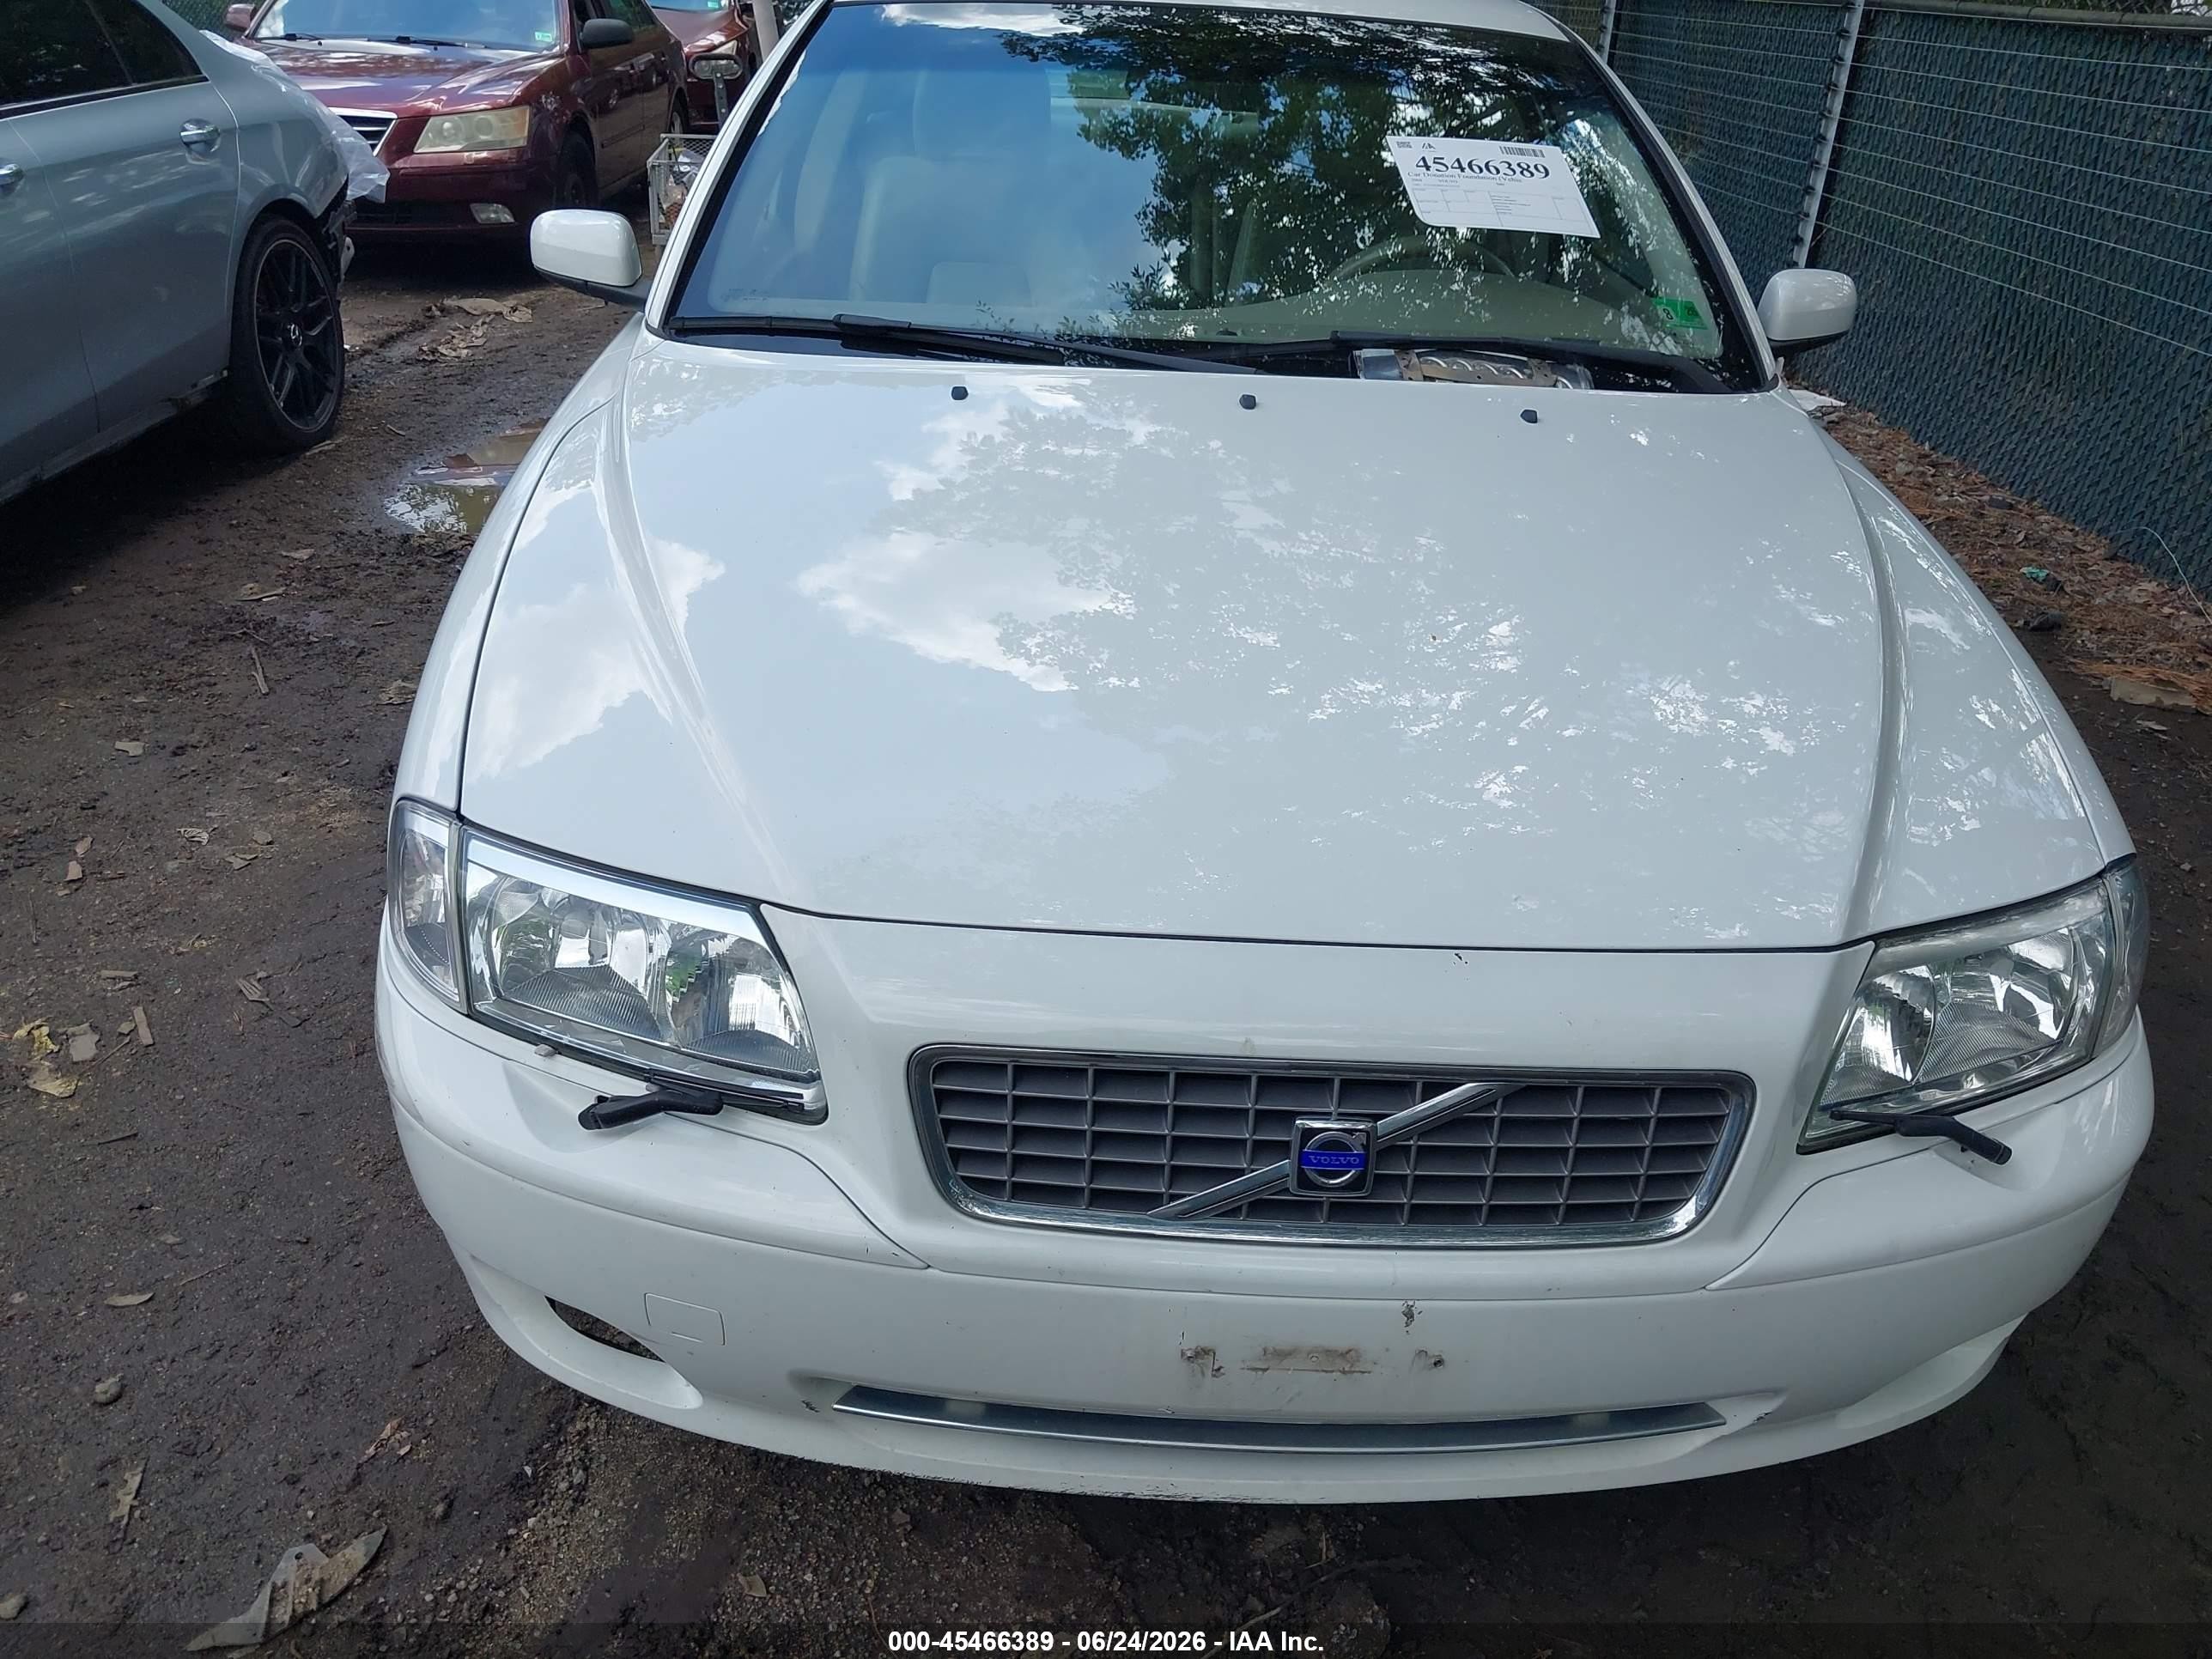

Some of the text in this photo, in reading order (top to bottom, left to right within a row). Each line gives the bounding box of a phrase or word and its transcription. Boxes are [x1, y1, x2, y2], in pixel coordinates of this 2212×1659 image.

[1415, 155, 1550, 179] 45466389
[1662, 307, 1674, 320] 8
[1308, 1155, 1360, 1164] VOLVO
